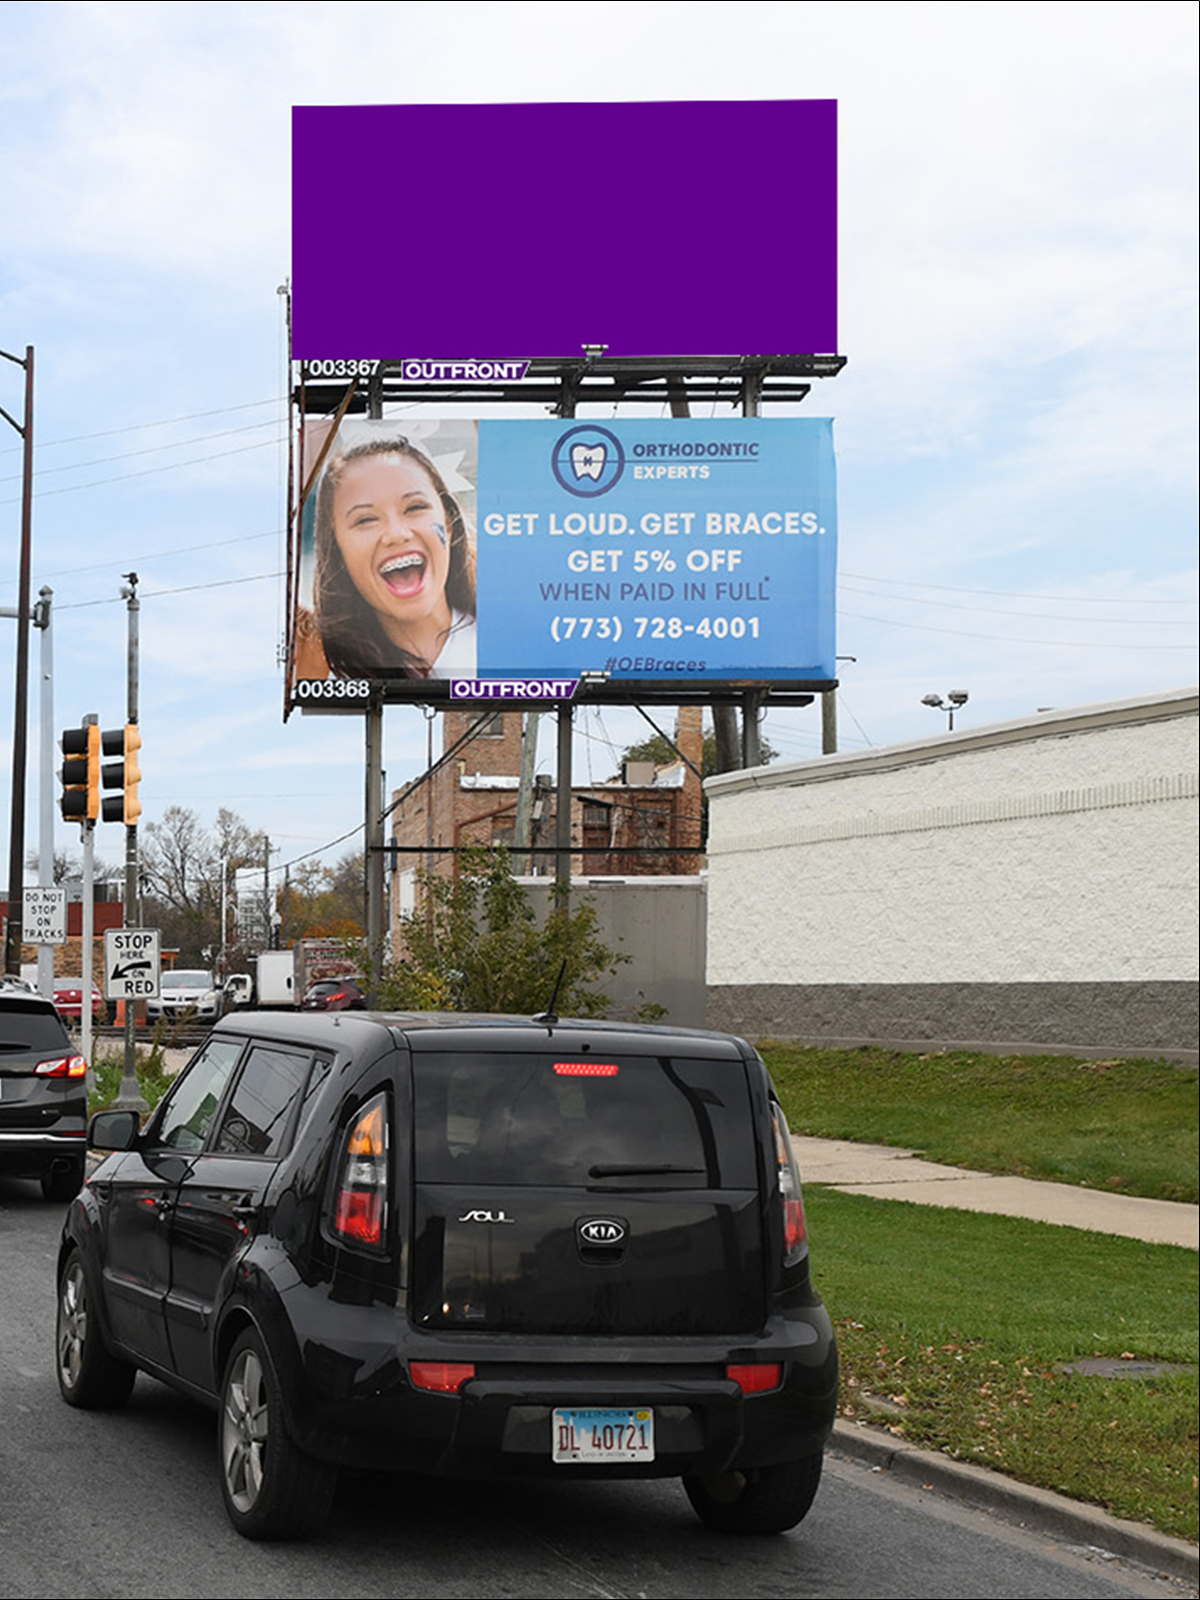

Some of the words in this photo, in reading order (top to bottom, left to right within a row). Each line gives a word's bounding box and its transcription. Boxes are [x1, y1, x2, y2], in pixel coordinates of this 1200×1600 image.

[309, 360, 380, 376] 003367
[405, 363, 523, 379] OUTFRONT
[632, 442, 760, 457] ORTHODONTIC
[633, 466, 710, 479] EXPERTS
[483, 513, 539, 536] GET
[549, 513, 635, 536] LOUD.
[640, 513, 696, 535] GET
[706, 512, 826, 535] BRACES.
[567, 550, 623, 572] GET
[633, 550, 676, 572] 5%
[686, 550, 742, 572] OFF
[539, 583, 610, 601] WHEN
[620, 583, 674, 600] PAID
[684, 583, 706, 600] IN
[551, 617, 623, 642] (773)
[634, 617, 760, 639] 728-4001
[604, 657, 707, 672] #OEBraces
[299, 680, 370, 698] 003368
[454, 681, 573, 697] OUTFRONT
[25, 893, 39, 902] DO
[43, 893, 62, 902] NOT
[31, 905, 57, 914] STOP
[37, 918, 51, 926] ON
[24, 929, 64, 938] TRACKS
[114, 935, 153, 949] STOP
[125, 981, 154, 994] RED
[458, 1210, 515, 1222] SOUL
[588, 1226, 617, 1237] KIA
[559, 1425, 580, 1450] DL
[592, 1424, 648, 1450] 40721
